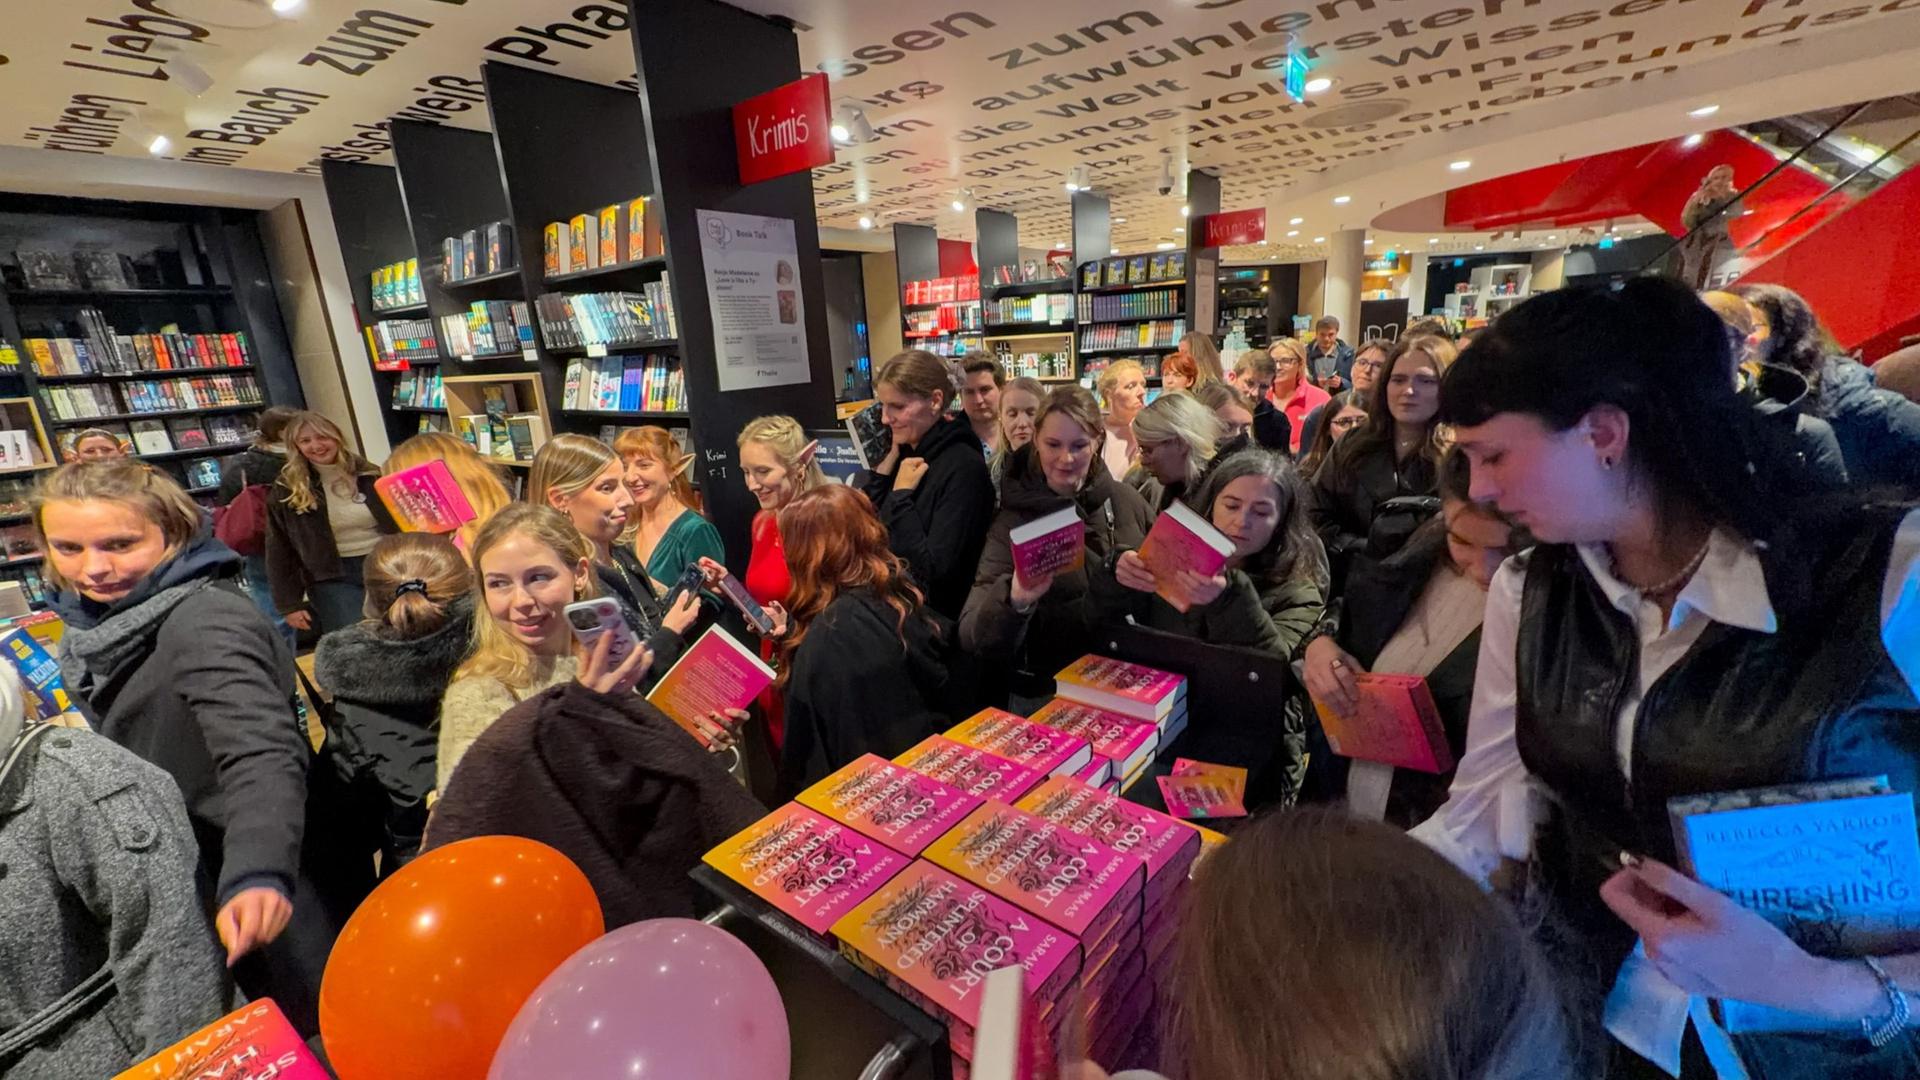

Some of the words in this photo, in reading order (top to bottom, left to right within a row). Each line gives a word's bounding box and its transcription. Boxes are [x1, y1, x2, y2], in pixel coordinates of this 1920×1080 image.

[298, 9, 434, 76] zum
[484, 0, 632, 66] Pha
[987, 10, 1164, 70] zum
[185, 87, 330, 146] Bauch
[747, 107, 809, 158] Krimis
[955, 120, 1034, 143] die
[964, 158, 1040, 182] gut
[1074, 132, 1158, 157] mit
[705, 449, 727, 462] Krimi
[999, 761, 1014, 772] A
[889, 795, 907, 811] OF
[932, 787, 948, 797] A
[883, 797, 935, 837] COURT
[1140, 812, 1158, 825] A
[1705, 823, 1805, 845] REBECCA
[740, 817, 820, 873] HARMONY
[753, 824, 842, 887] SPLINTERED
[855, 843, 873, 857] A
[965, 814, 1031, 871] HARMONY
[986, 823, 1057, 885] SPLINTERED
[1080, 843, 1099, 855] A
[808, 856, 826, 872] OF
[857, 855, 893, 884] SARAH
[1035, 855, 1053, 871] OF
[1035, 857, 1087, 908] COURT
[1095, 855, 1125, 886] SARAH
[794, 858, 857, 908] COURT
[815, 890, 850, 918] MAAS
[877, 880, 959, 950] HARMONY
[1064, 891, 1093, 919] MAAS
[896, 890, 987, 970] SPLINTERED
[955, 931, 977, 952] OF
[1009, 916, 1030, 933] A
[949, 936, 1015, 1001] COURT
[1019, 934, 1058, 973] SARAH
[174, 1004, 270, 1061] SARAH
